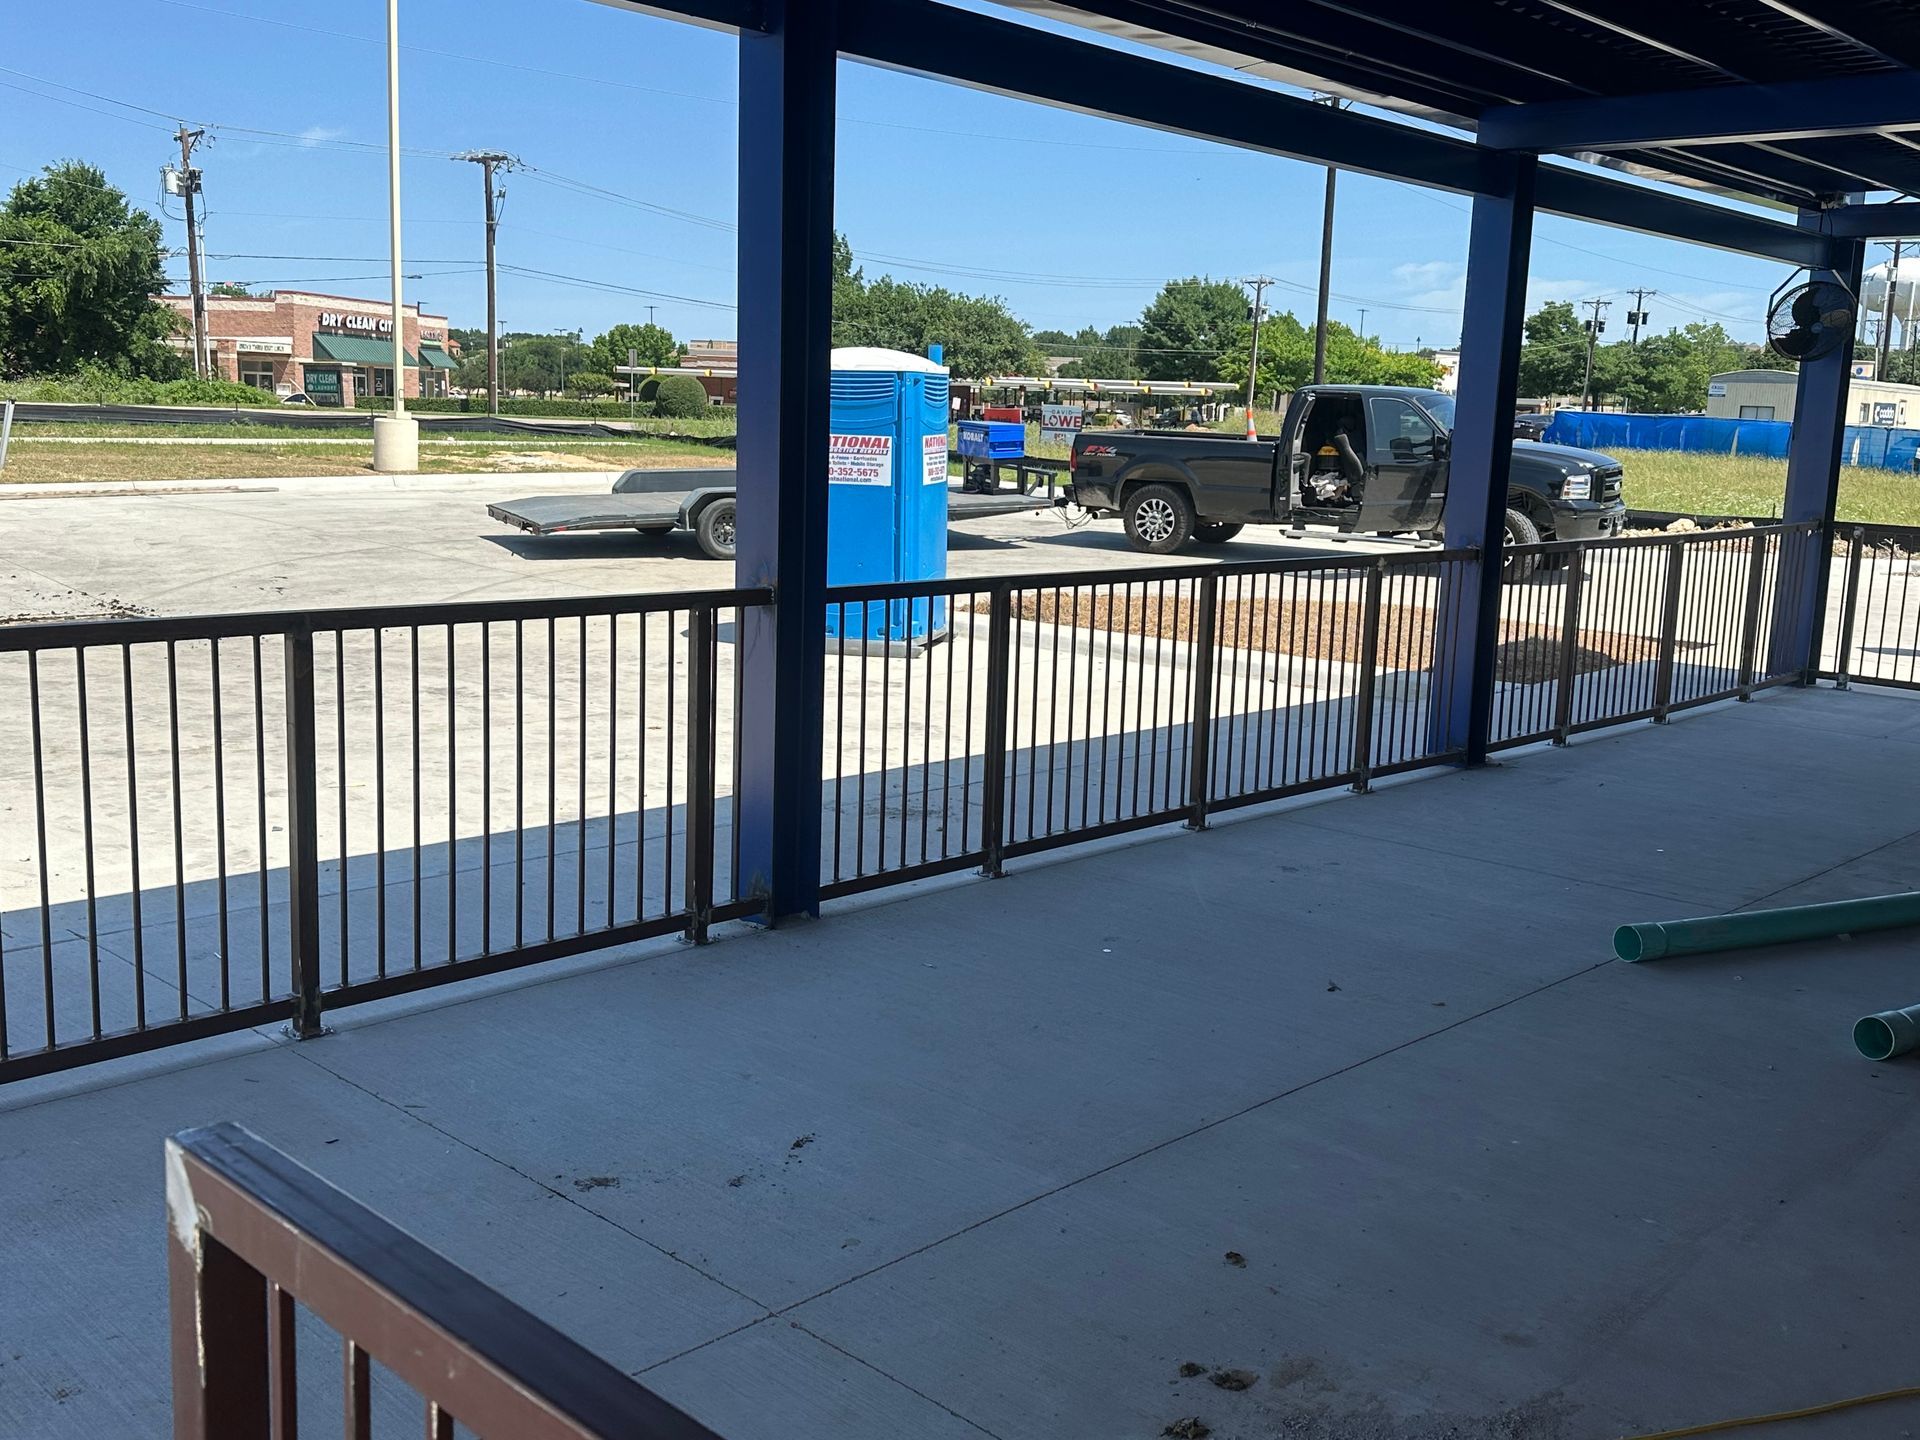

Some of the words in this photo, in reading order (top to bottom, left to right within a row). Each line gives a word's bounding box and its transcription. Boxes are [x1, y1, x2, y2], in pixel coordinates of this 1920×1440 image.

[321, 312, 344, 327] DRY
[345, 314, 377, 331] CLEAN
[378, 319, 394, 333] CIT
[305, 373, 317, 384] DRY
[318, 373, 337, 384] CLEAN
[1042, 414, 1082, 428] LOWE
[829, 436, 890, 449] TIONAL
[962, 431, 984, 443] KOBALT
[1086, 444, 1118, 454] FX4
[829, 467, 879, 477] 0-352-5675
